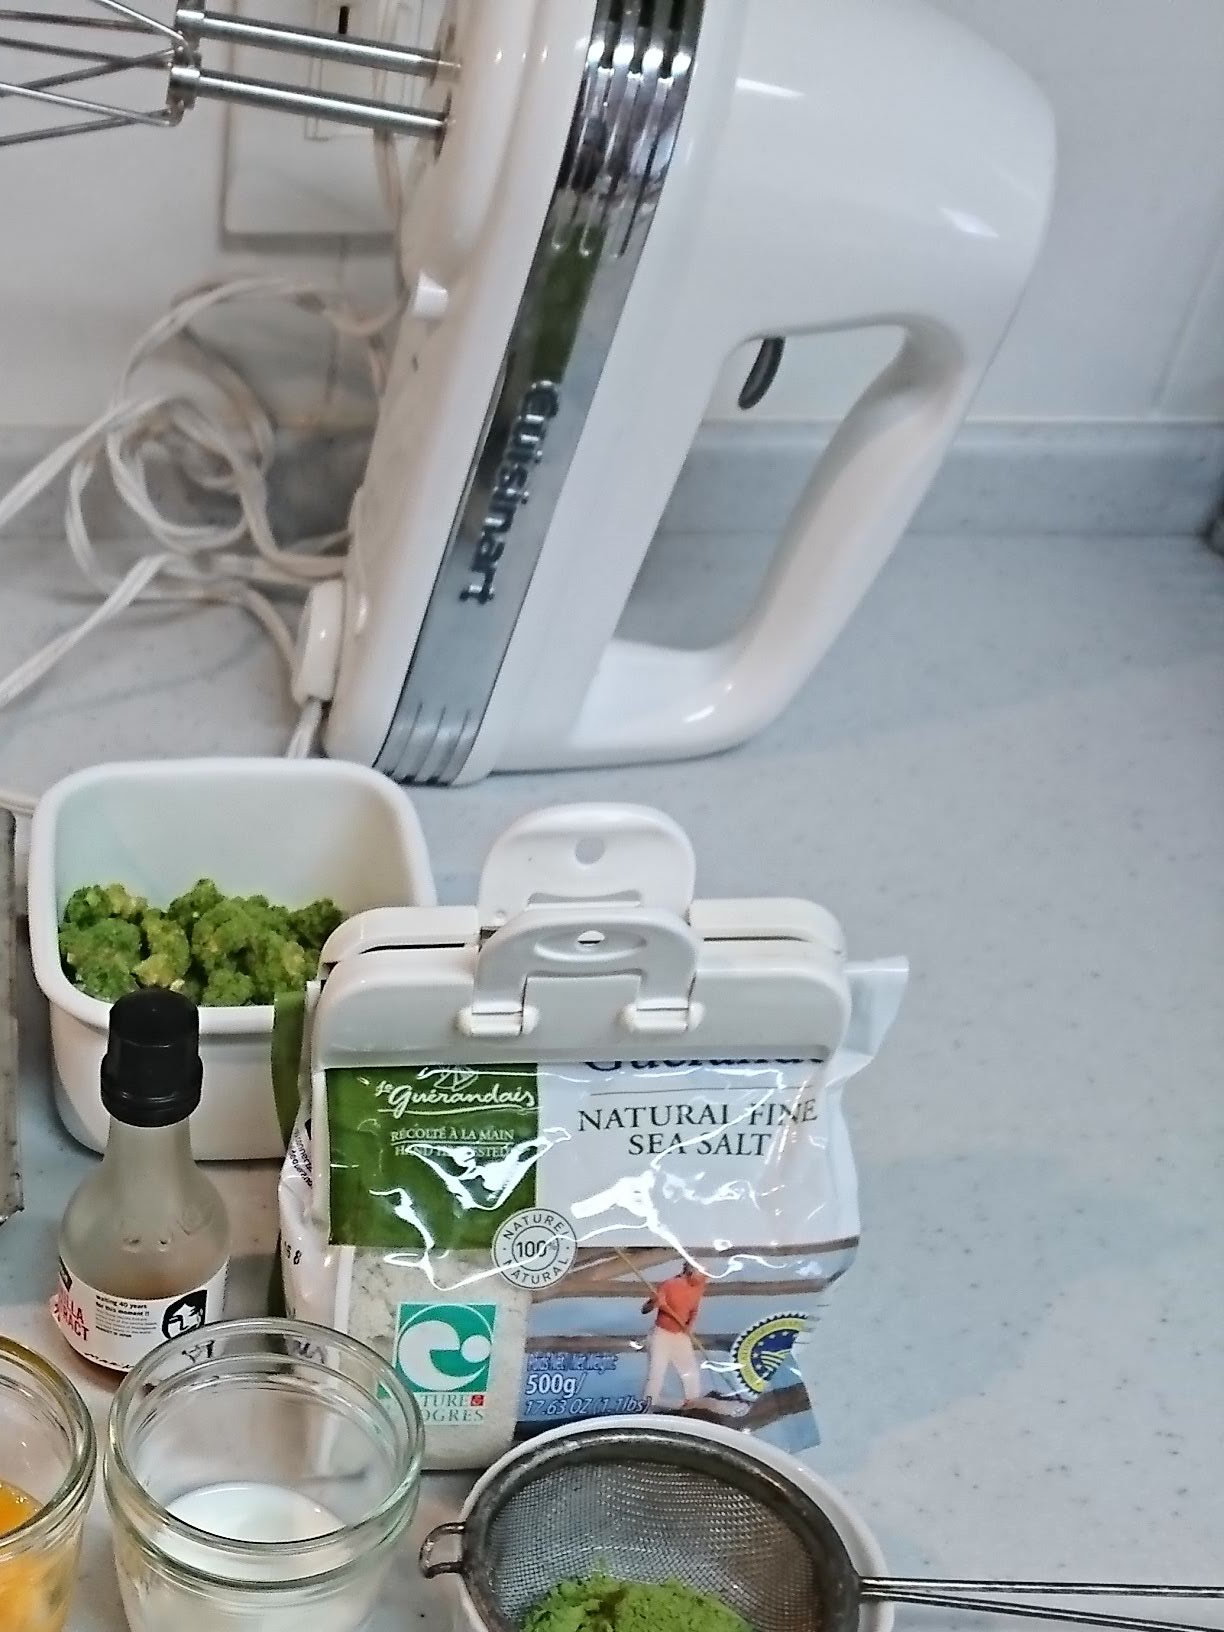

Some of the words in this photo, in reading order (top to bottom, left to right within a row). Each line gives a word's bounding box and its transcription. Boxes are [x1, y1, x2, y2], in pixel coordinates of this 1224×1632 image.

[459, 379, 561, 605] Cuisinart
[388, 1083, 536, 1119] Guérandais
[579, 1104, 730, 1132] NATURAL
[749, 1099, 819, 1127] FINE
[461, 1129, 477, 1140] LA
[477, 1128, 515, 1141] MAIN
[628, 1133, 688, 1156] SEA
[696, 1132, 772, 1156] SALT
[526, 1400, 566, 1415] 17.63
[569, 1399, 593, 1414] OZ
